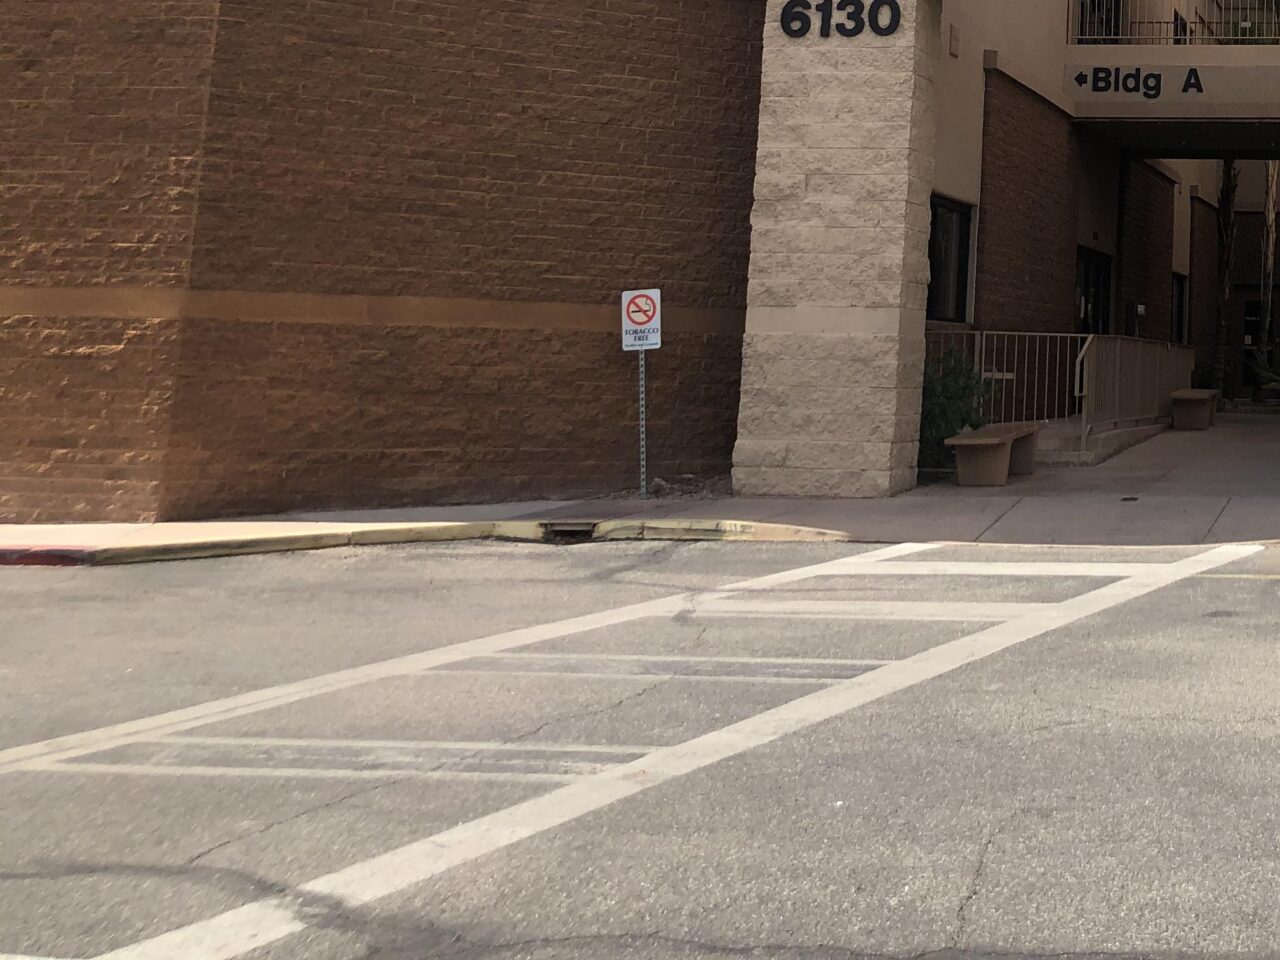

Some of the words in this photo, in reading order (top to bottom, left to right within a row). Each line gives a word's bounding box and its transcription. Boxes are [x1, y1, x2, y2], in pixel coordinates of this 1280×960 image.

[1091, 67, 1162, 99] Bldg
[1181, 68, 1204, 93] A
[625, 327, 659, 336] TOBACCO
